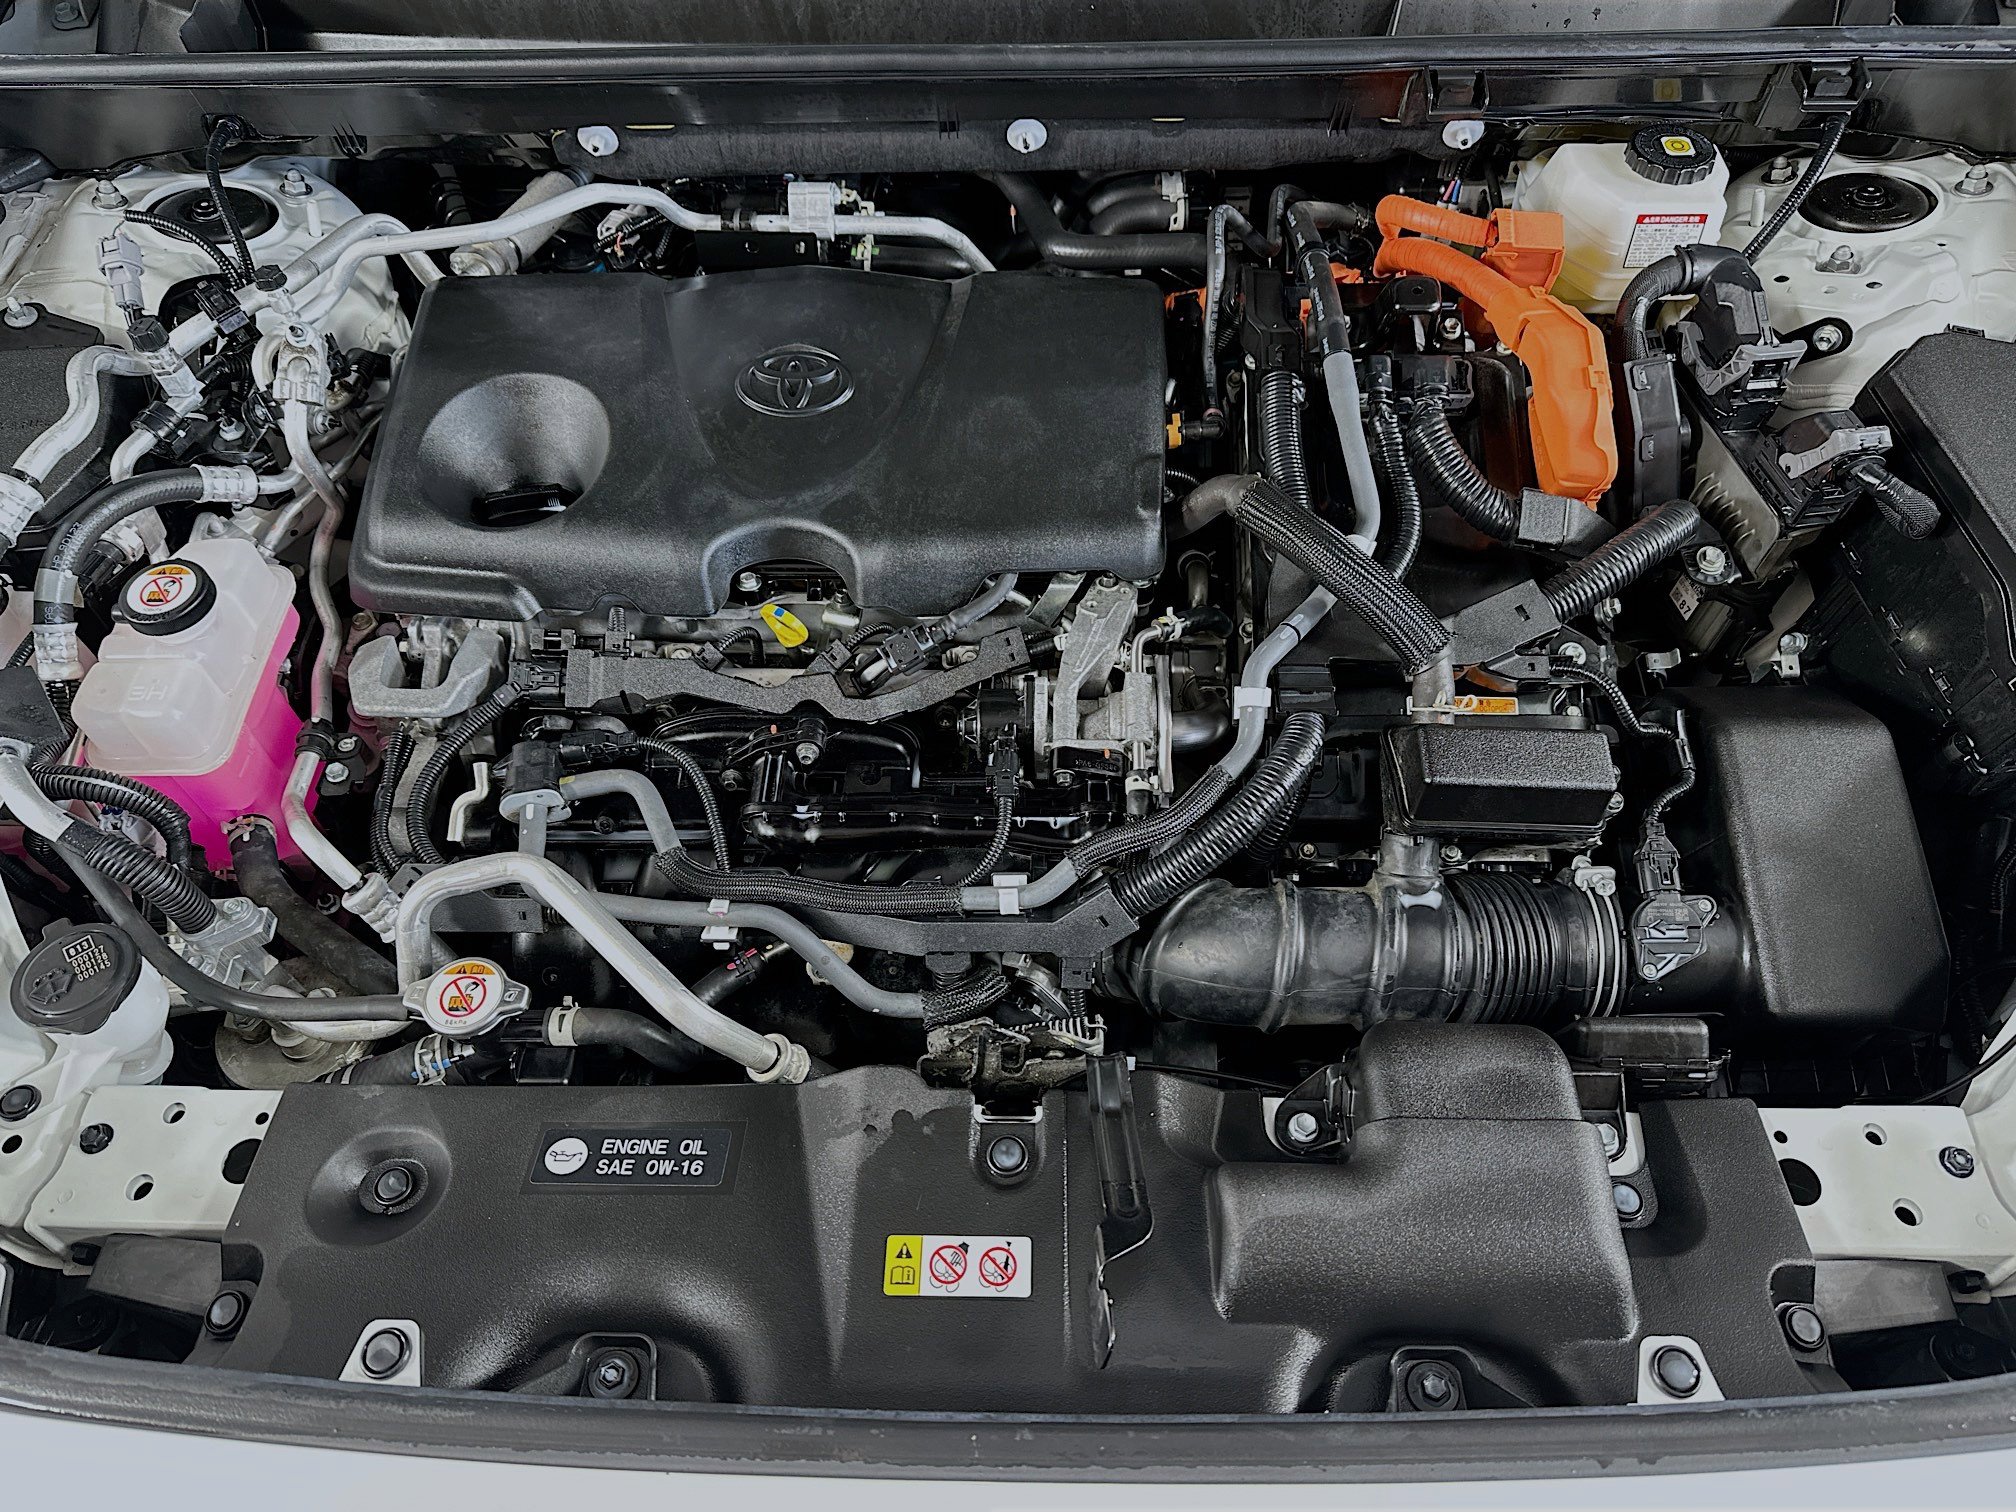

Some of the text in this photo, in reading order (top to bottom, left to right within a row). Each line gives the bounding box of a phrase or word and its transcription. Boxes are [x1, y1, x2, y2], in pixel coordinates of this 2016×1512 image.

[1660, 215, 1689, 223] DANGER
[1679, 600, 1691, 614] 87
[71, 945, 104, 967] 000127
[74, 953, 108, 974] 000128
[77, 960, 111, 982] 000145
[600, 1138, 708, 1156] ENGINE OIL
[595, 1159, 704, 1176] SAE 0W-16
